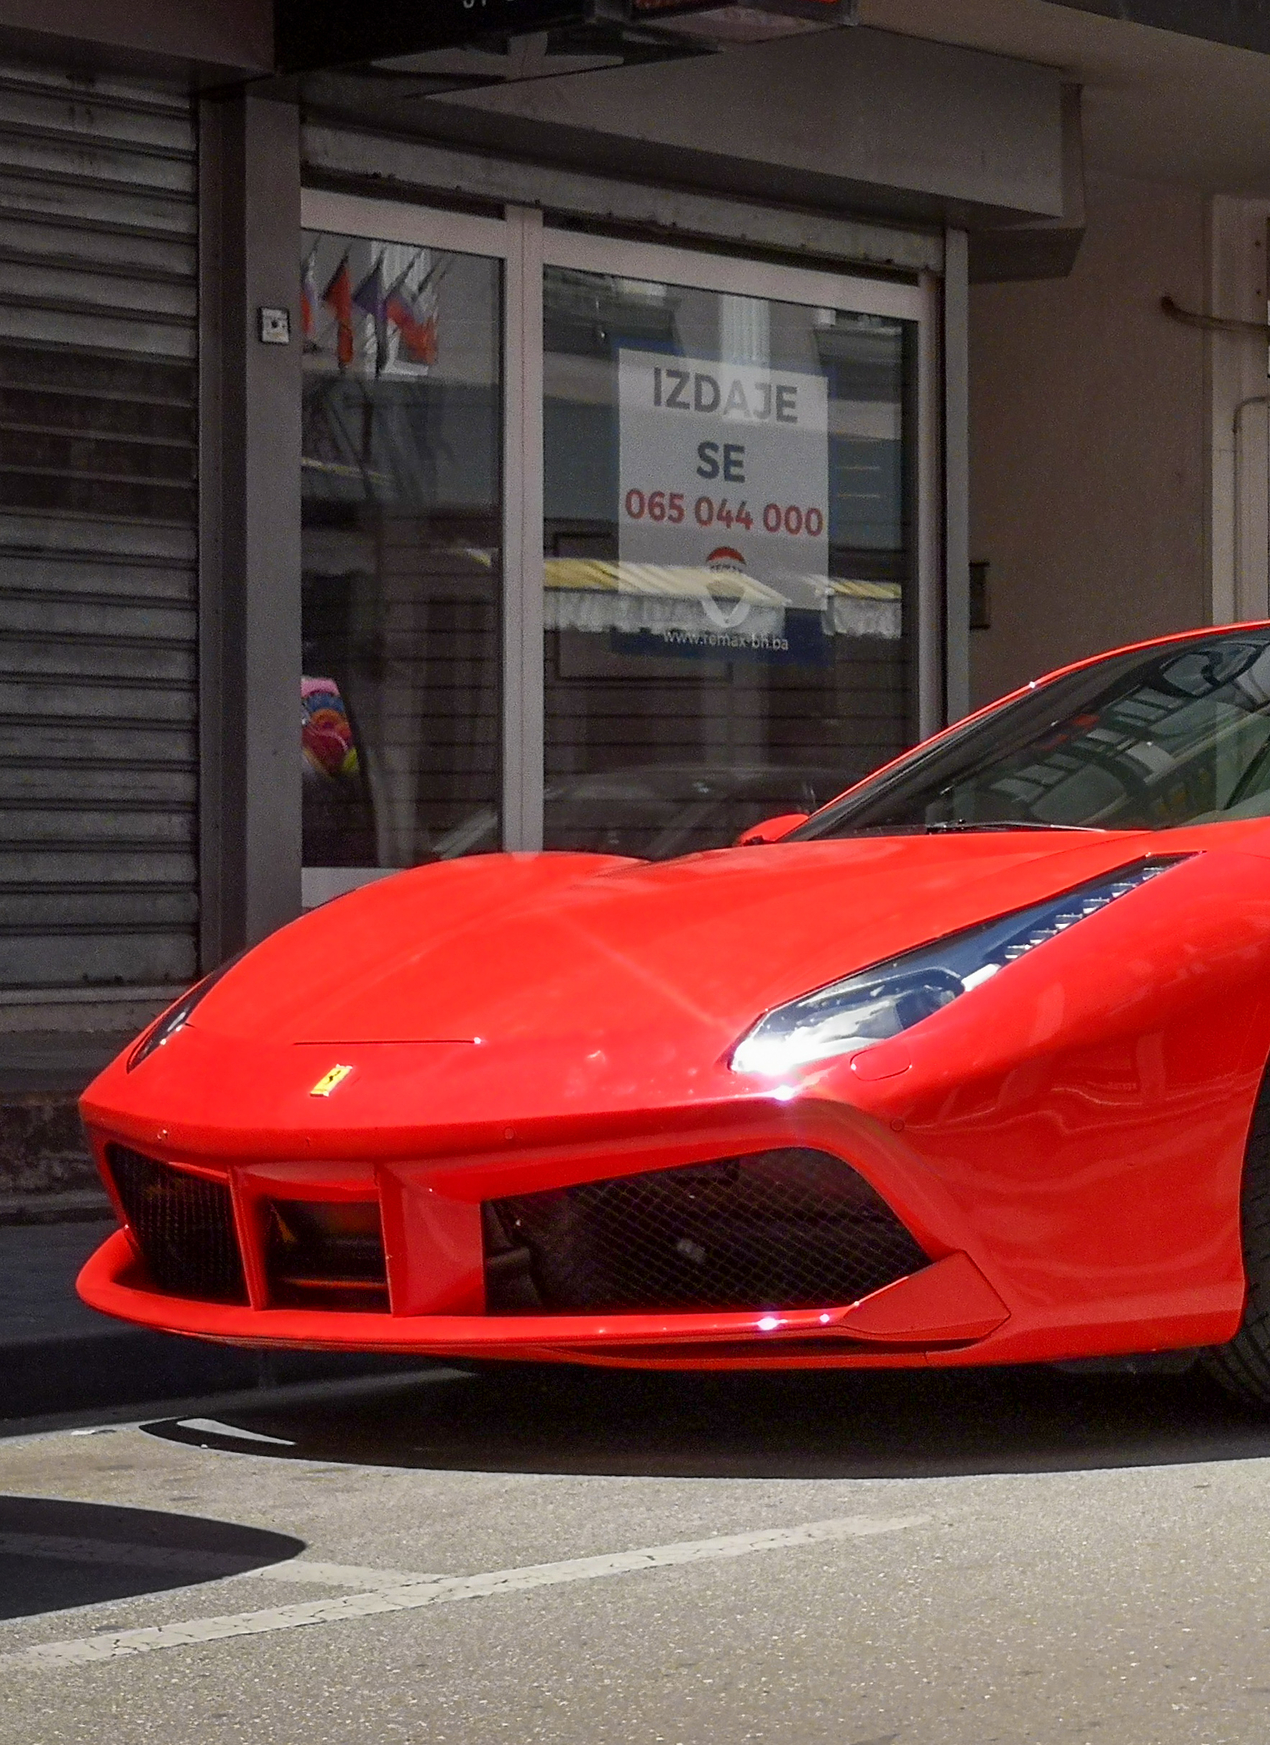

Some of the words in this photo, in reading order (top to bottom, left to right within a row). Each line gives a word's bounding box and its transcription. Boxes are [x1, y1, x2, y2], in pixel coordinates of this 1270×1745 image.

[653, 366, 798, 424] IZDAJE
[696, 440, 746, 484] SE
[624, 488, 685, 524] 065
[694, 496, 754, 530] 044
[763, 503, 824, 537] 000
